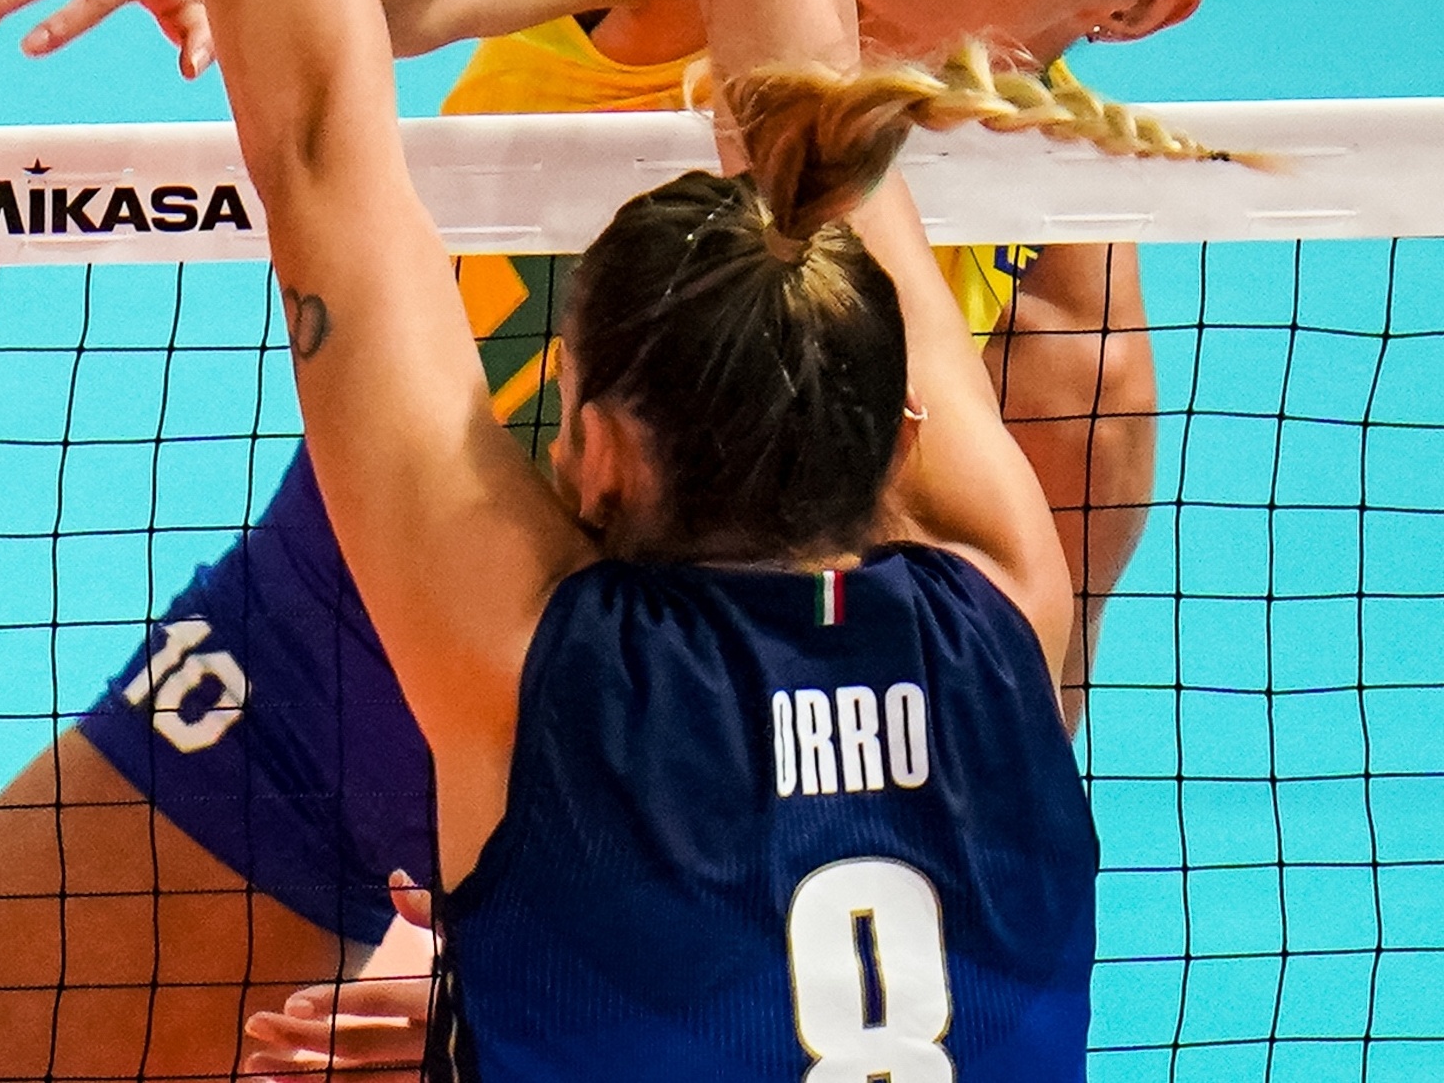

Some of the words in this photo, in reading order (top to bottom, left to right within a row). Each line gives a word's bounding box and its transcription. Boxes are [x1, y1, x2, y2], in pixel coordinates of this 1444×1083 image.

[123, 614, 251, 754] 10
[771, 681, 930, 798] ORRO
[786, 856, 955, 1083] 8
